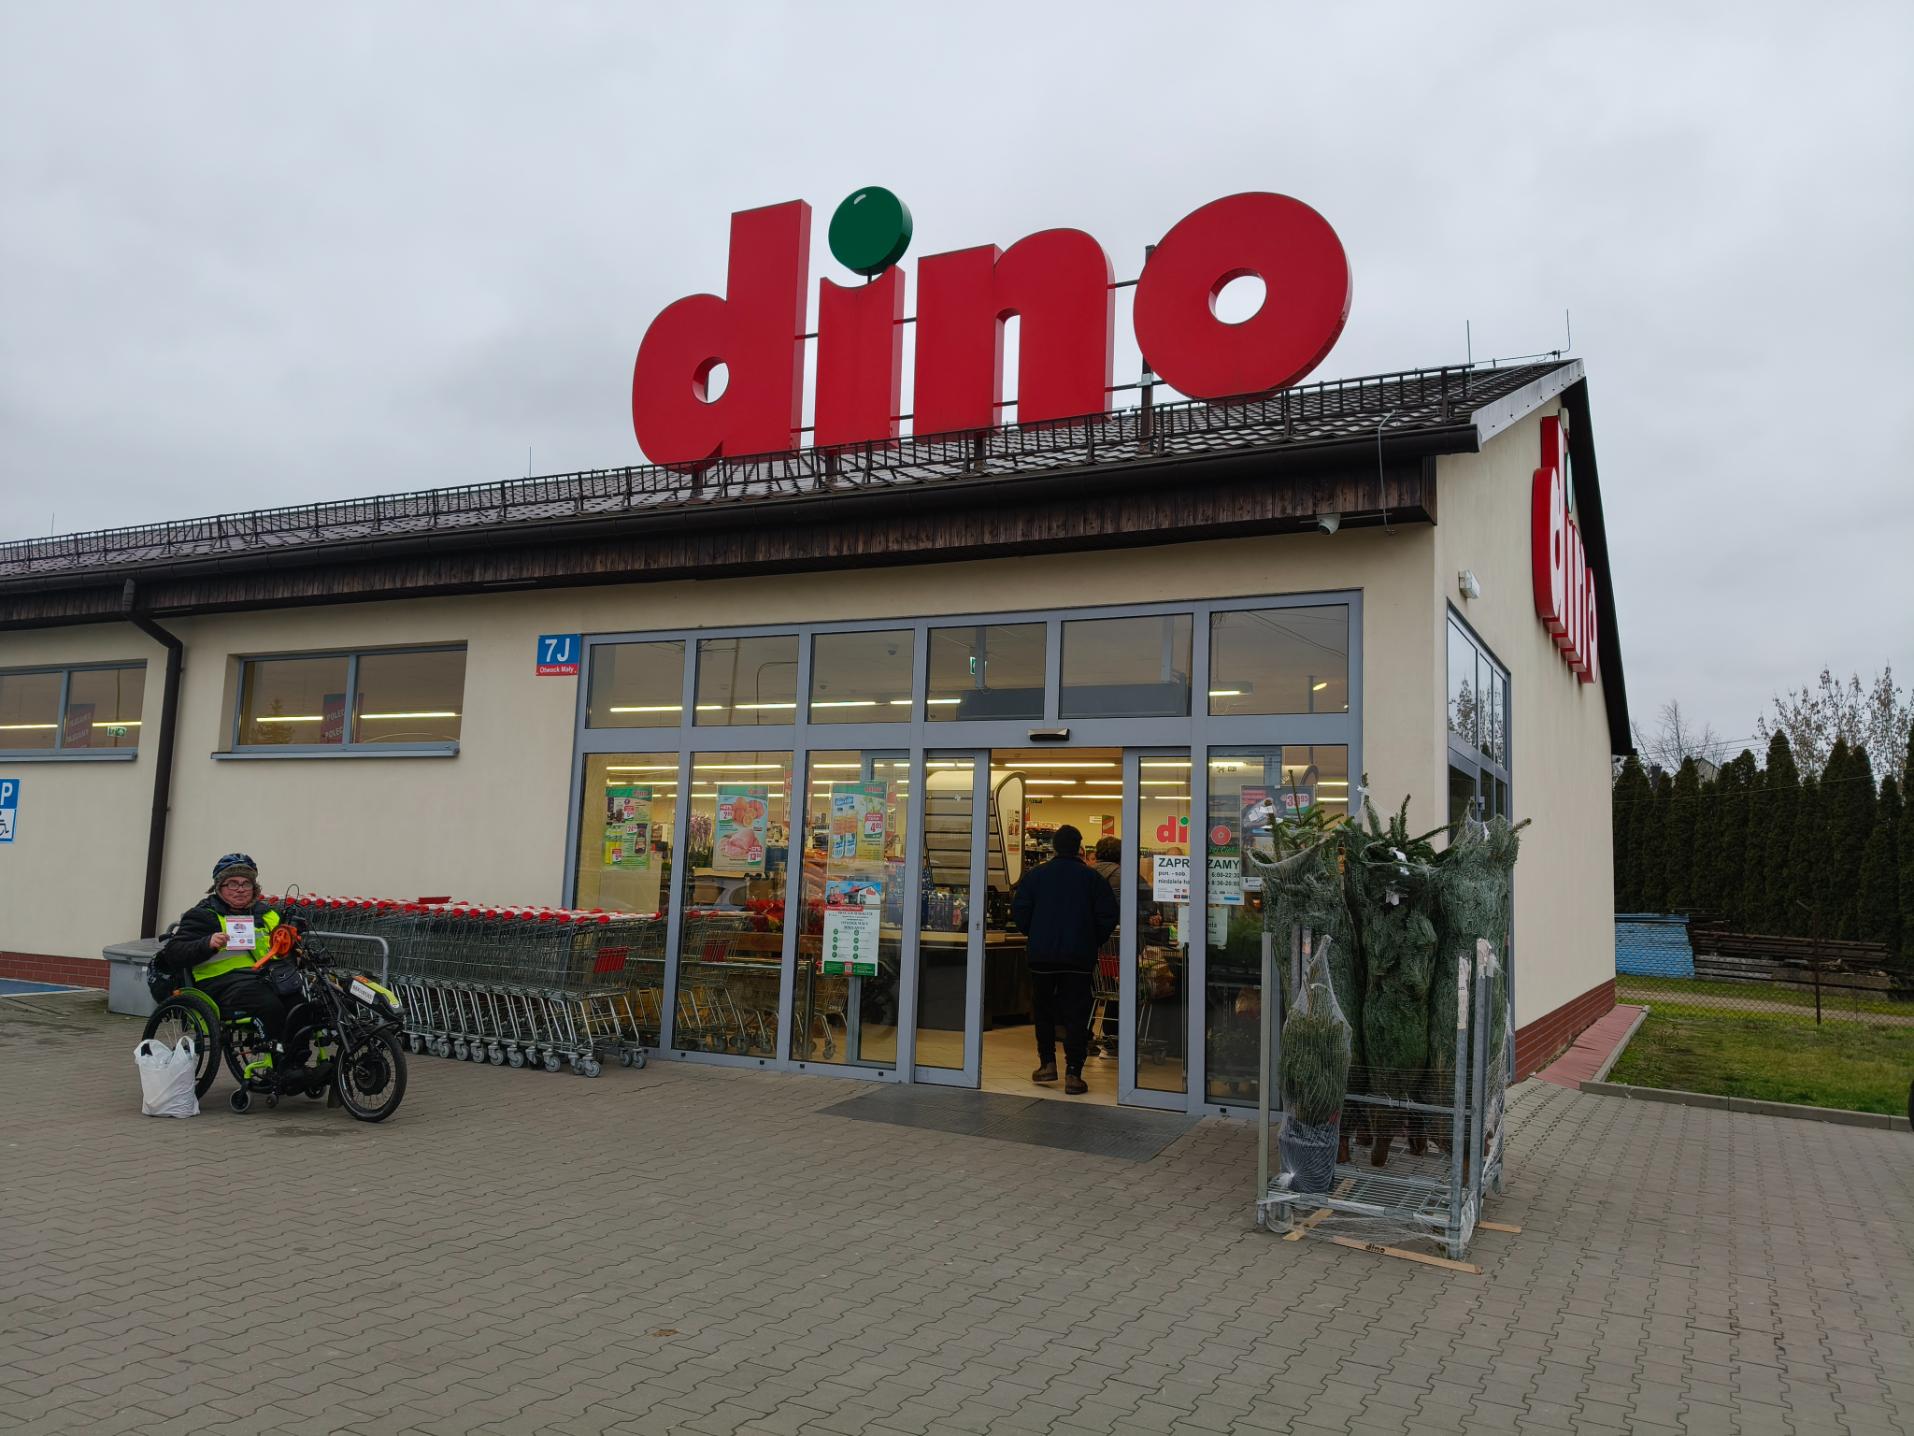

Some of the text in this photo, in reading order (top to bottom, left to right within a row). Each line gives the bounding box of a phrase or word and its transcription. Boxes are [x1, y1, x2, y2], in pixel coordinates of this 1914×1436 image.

[632, 185, 1353, 471] dino
[1531, 415, 1599, 684] dino
[545, 638, 570, 662] 7J
[0, 782, 13, 806] P
[1158, 857, 1240, 870] ZAPRZAMY
